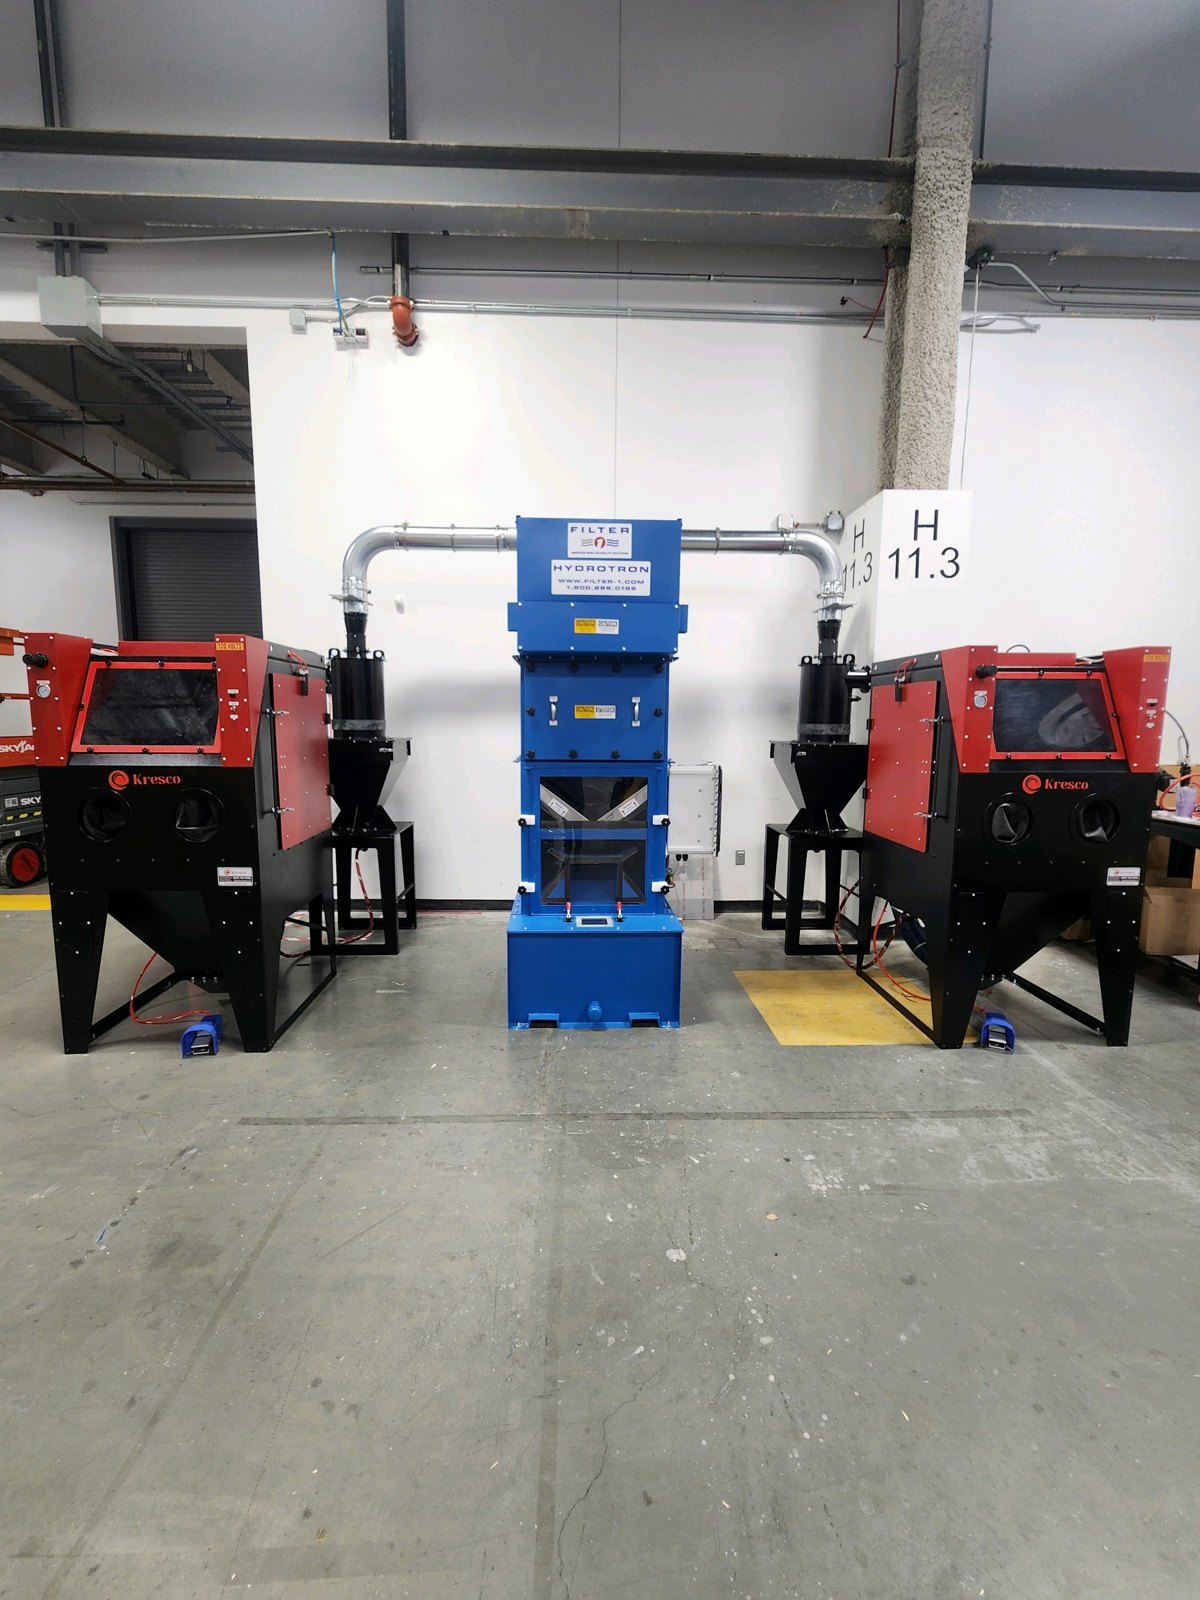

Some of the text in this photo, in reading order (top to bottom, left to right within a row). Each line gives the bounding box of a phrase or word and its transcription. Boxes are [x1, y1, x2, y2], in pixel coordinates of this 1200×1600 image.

[570, 526, 630, 534] FILTER
[913, 509, 939, 541] H
[853, 518, 865, 553] H
[553, 565, 649, 573] HYDROTRON
[888, 546, 960, 579] 11.3
[843, 551, 873, 592] 11.3
[0, 740, 35, 753] SKYJA
[133, 774, 181, 785] Kresco
[1044, 779, 1089, 790] Kresco
